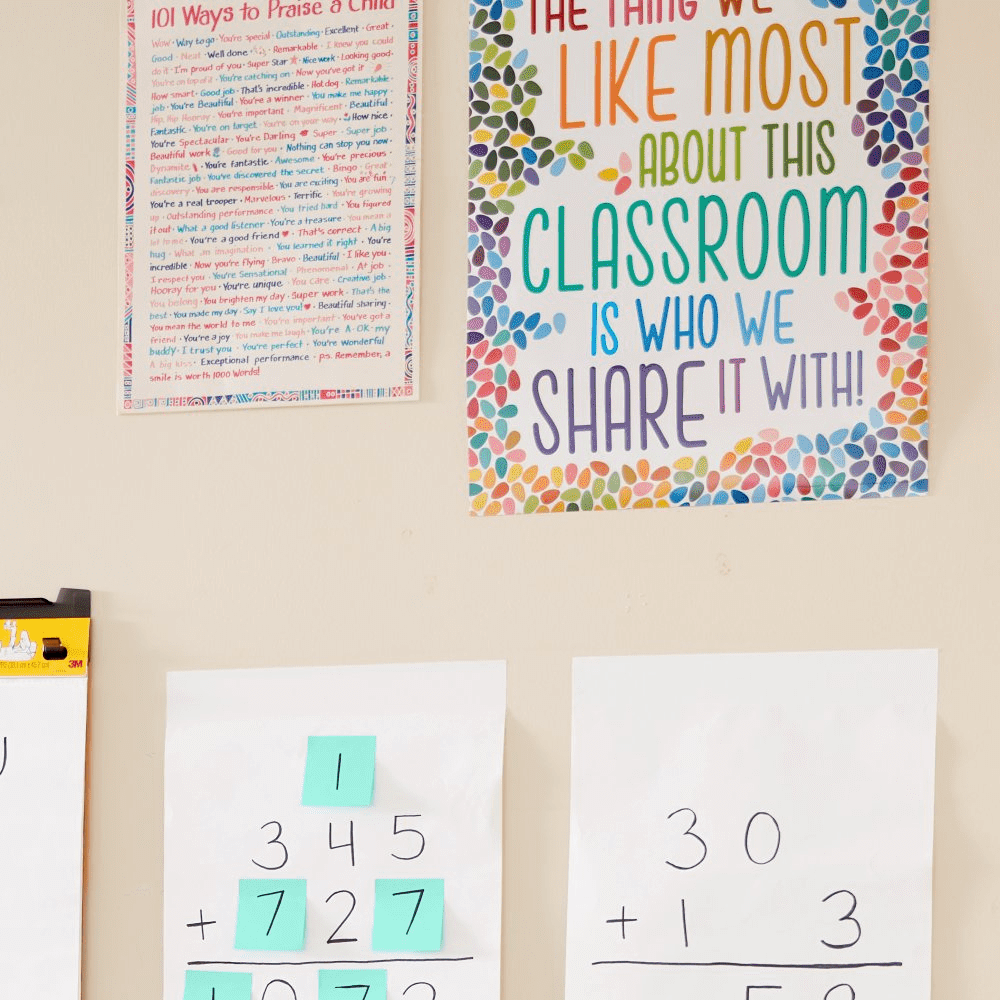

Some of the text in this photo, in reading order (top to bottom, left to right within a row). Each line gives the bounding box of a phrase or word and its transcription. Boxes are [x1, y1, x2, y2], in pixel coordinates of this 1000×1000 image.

[151, 7, 175, 28] 101
[181, 4, 234, 32] Ways
[239, 2, 260, 21] to
[267, 0, 323, 19] Praise
[329, 0, 341, 13] a
[530, 0, 588, 35] THE
[324, 24, 358, 35] Excellent
[366, 22, 388, 31] Great
[207, 48, 247, 58] Well done
[273, 42, 317, 53] Remarkable
[341, 50, 390, 62] Looking good
[190, 62, 241, 74] proud you
[247, 58, 287, 69] Super Star
[219, 71, 277, 82] You're catching
[295, 68, 313, 76] Now
[560, 17, 861, 129] LIKE MOST
[241, 82, 304, 94] That's incredible
[364, 87, 387, 97] happy
[170, 97, 233, 110] You're Beautiful
[239, 93, 304, 105] You're winner
[349, 98, 387, 108] Beautiful
[245, 107, 283, 119] important
[352, 111, 387, 121] How nice
[150, 126, 185, 136] Fantastic
[263, 130, 295, 142] Darling
[150, 135, 228, 149] You're Spectacular
[286, 142, 316, 154] Nothing
[150, 148, 210, 160] Beautiful work
[274, 154, 314, 164] Awesome
[321, 150, 386, 162] You're precious
[639, 120, 836, 188] ABOUT THIS
[204, 158, 268, 169] You're fantastic
[332, 163, 357, 173] Bingo
[233, 166, 324, 179] discovered secret
[228, 181, 274, 193] responsible
[293, 190, 321, 199] Terrific
[150, 196, 235, 209] You're trooper
[167, 206, 273, 221] Outstanding performance
[231, 219, 263, 230] listener
[270, 214, 341, 227] You're treasure
[327, 225, 361, 234] correct
[190, 231, 279, 244] You're good friend
[522, 185, 868, 293] CLASSROOM
[302, 252, 339, 262] Beautiful
[150, 262, 187, 272] incredible
[239, 268, 287, 278] Sensational
[150, 284, 182, 295] Hooray
[222, 280, 282, 290] You're unique
[218, 294, 254, 304] brighten
[318, 298, 386, 310] Beautiful sharing
[203, 320, 227, 329] world
[590, 288, 794, 356] IS WHO WE
[190, 344, 213, 354] trust
[270, 340, 303, 350] perfect
[200, 353, 309, 367] Exceptional performance
[149, 372, 171, 381] smile
[185, 371, 210, 380] worth
[213, 370, 230, 379] 1000
[532, 350, 864, 456] SHARE IT WITH!
[68, 660, 83, 668] 3M
[256, 889, 285, 937] 7
[392, 888, 425, 935] 7
[820, 889, 862, 949] 3
